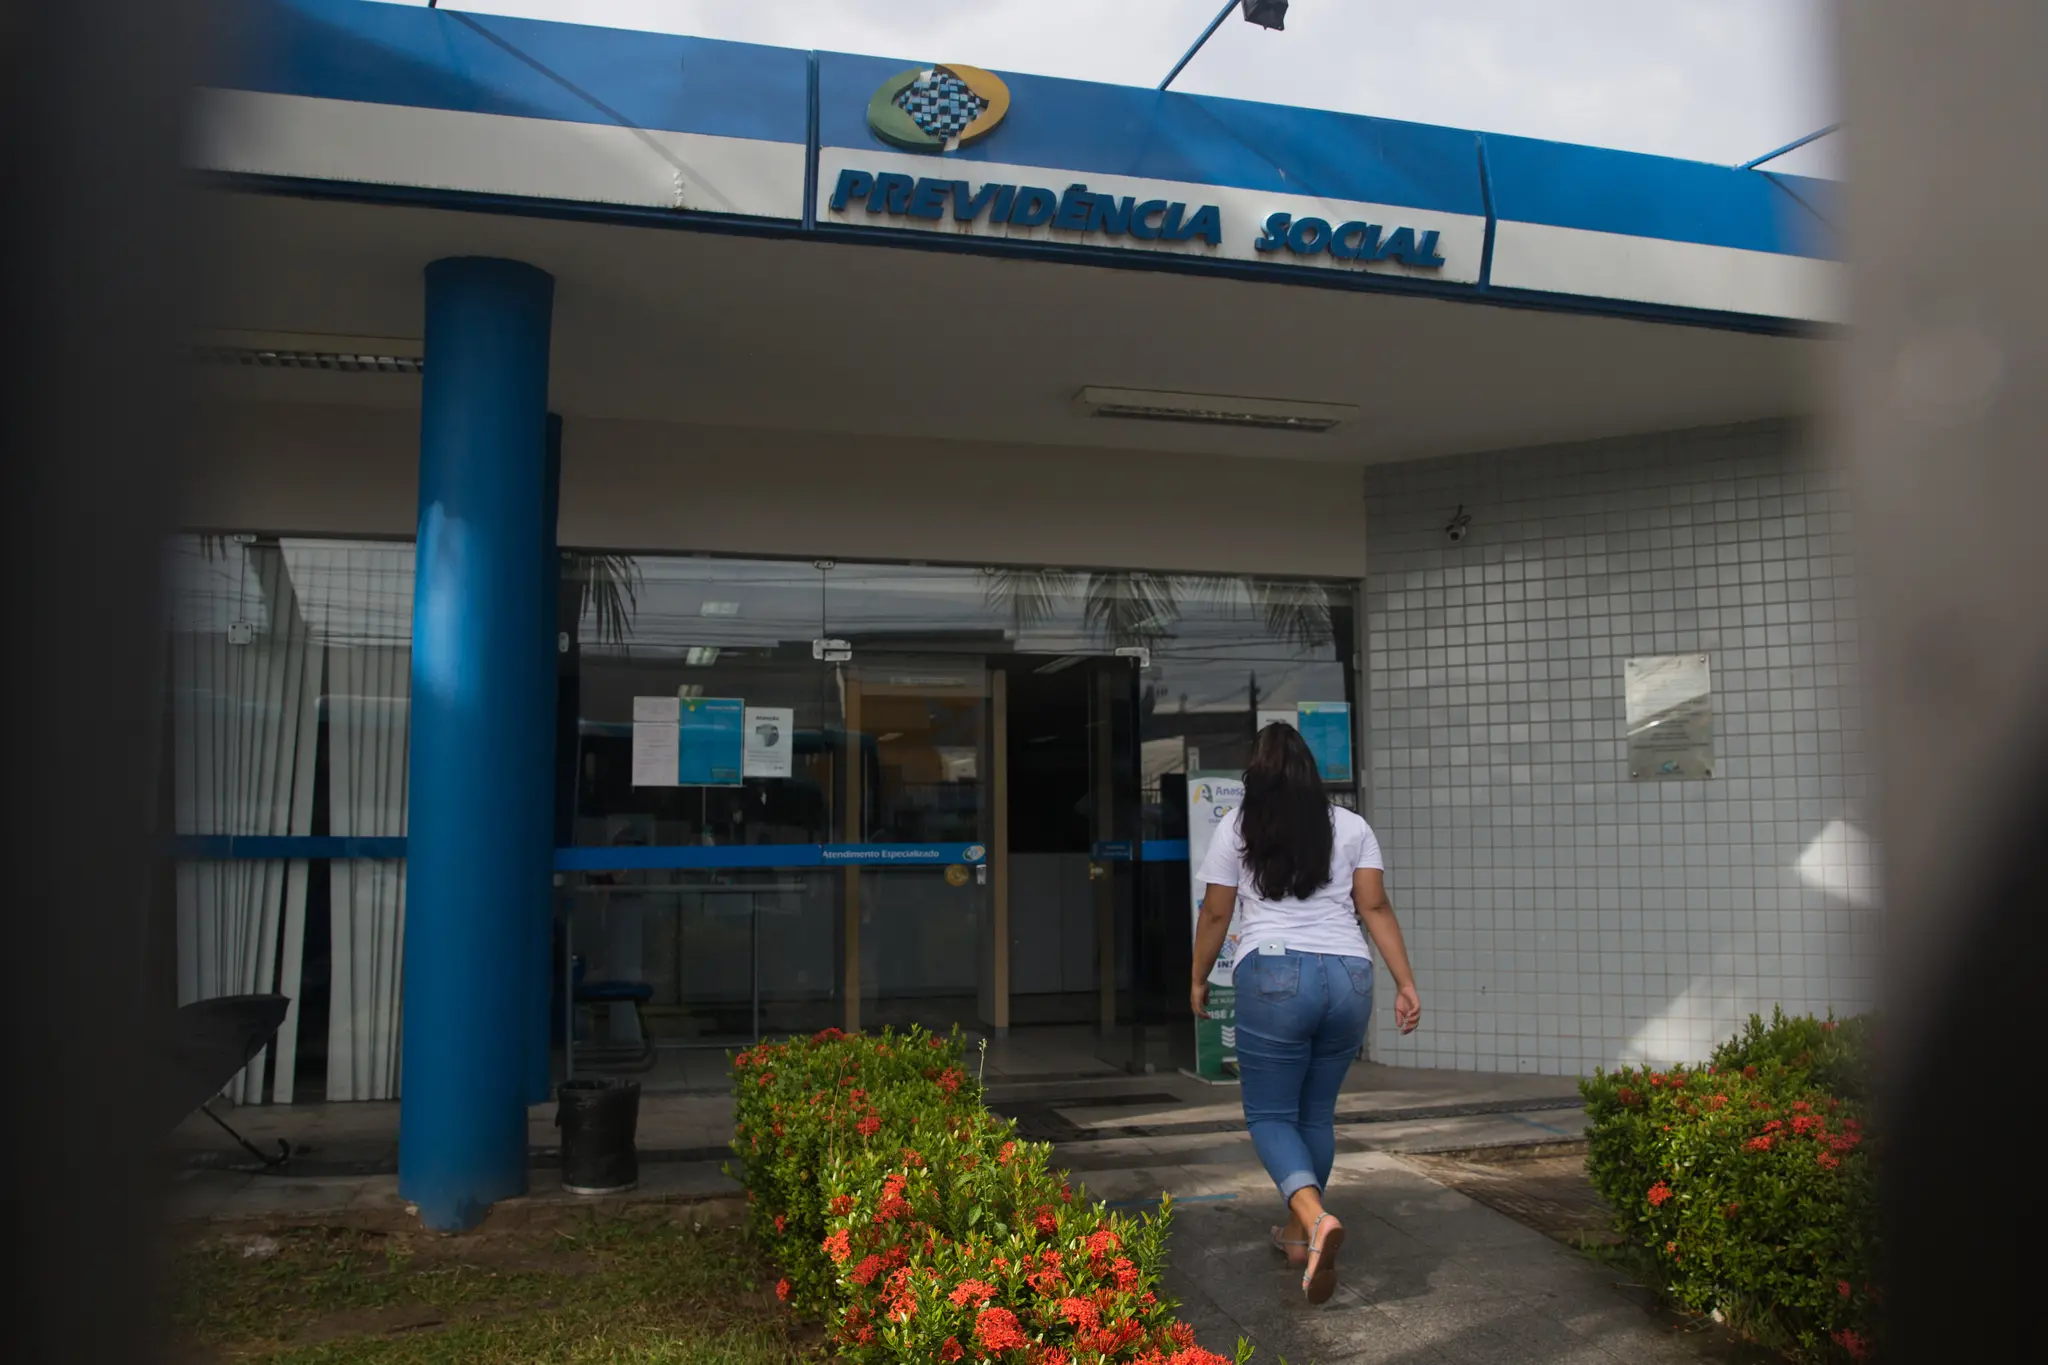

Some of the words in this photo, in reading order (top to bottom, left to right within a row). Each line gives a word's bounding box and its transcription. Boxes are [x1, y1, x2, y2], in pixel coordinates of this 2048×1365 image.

[831, 168, 1222, 245] PREVIDÊNCIA
[1255, 212, 1446, 268] SOCIAL
[822, 850, 880, 859] Atendimento
[881, 849, 940, 860] Especializado
